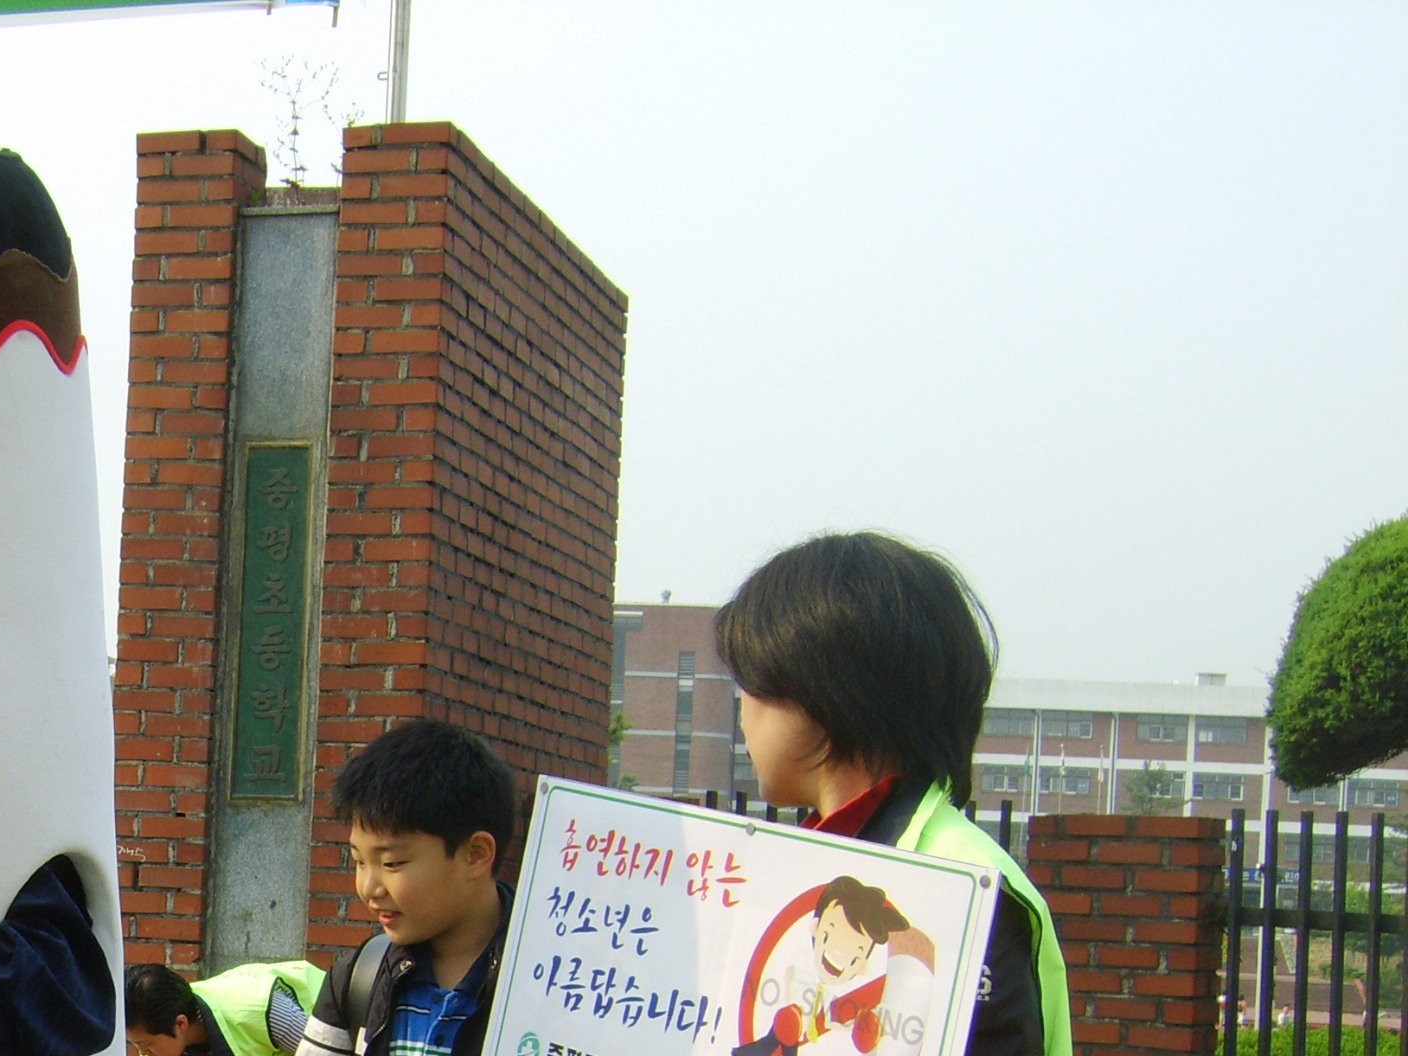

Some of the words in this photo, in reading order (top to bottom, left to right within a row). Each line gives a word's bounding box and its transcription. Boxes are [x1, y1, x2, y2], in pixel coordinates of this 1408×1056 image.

[247, 467, 298, 783] 증평초등학교
[560, 818, 674, 887] 흡연하지
[686, 850, 748, 908] 않는
[547, 886, 660, 956] 청소년은
[533, 955, 723, 1044] 아름답습니다!
[802, 987, 925, 1046] SMOKING
